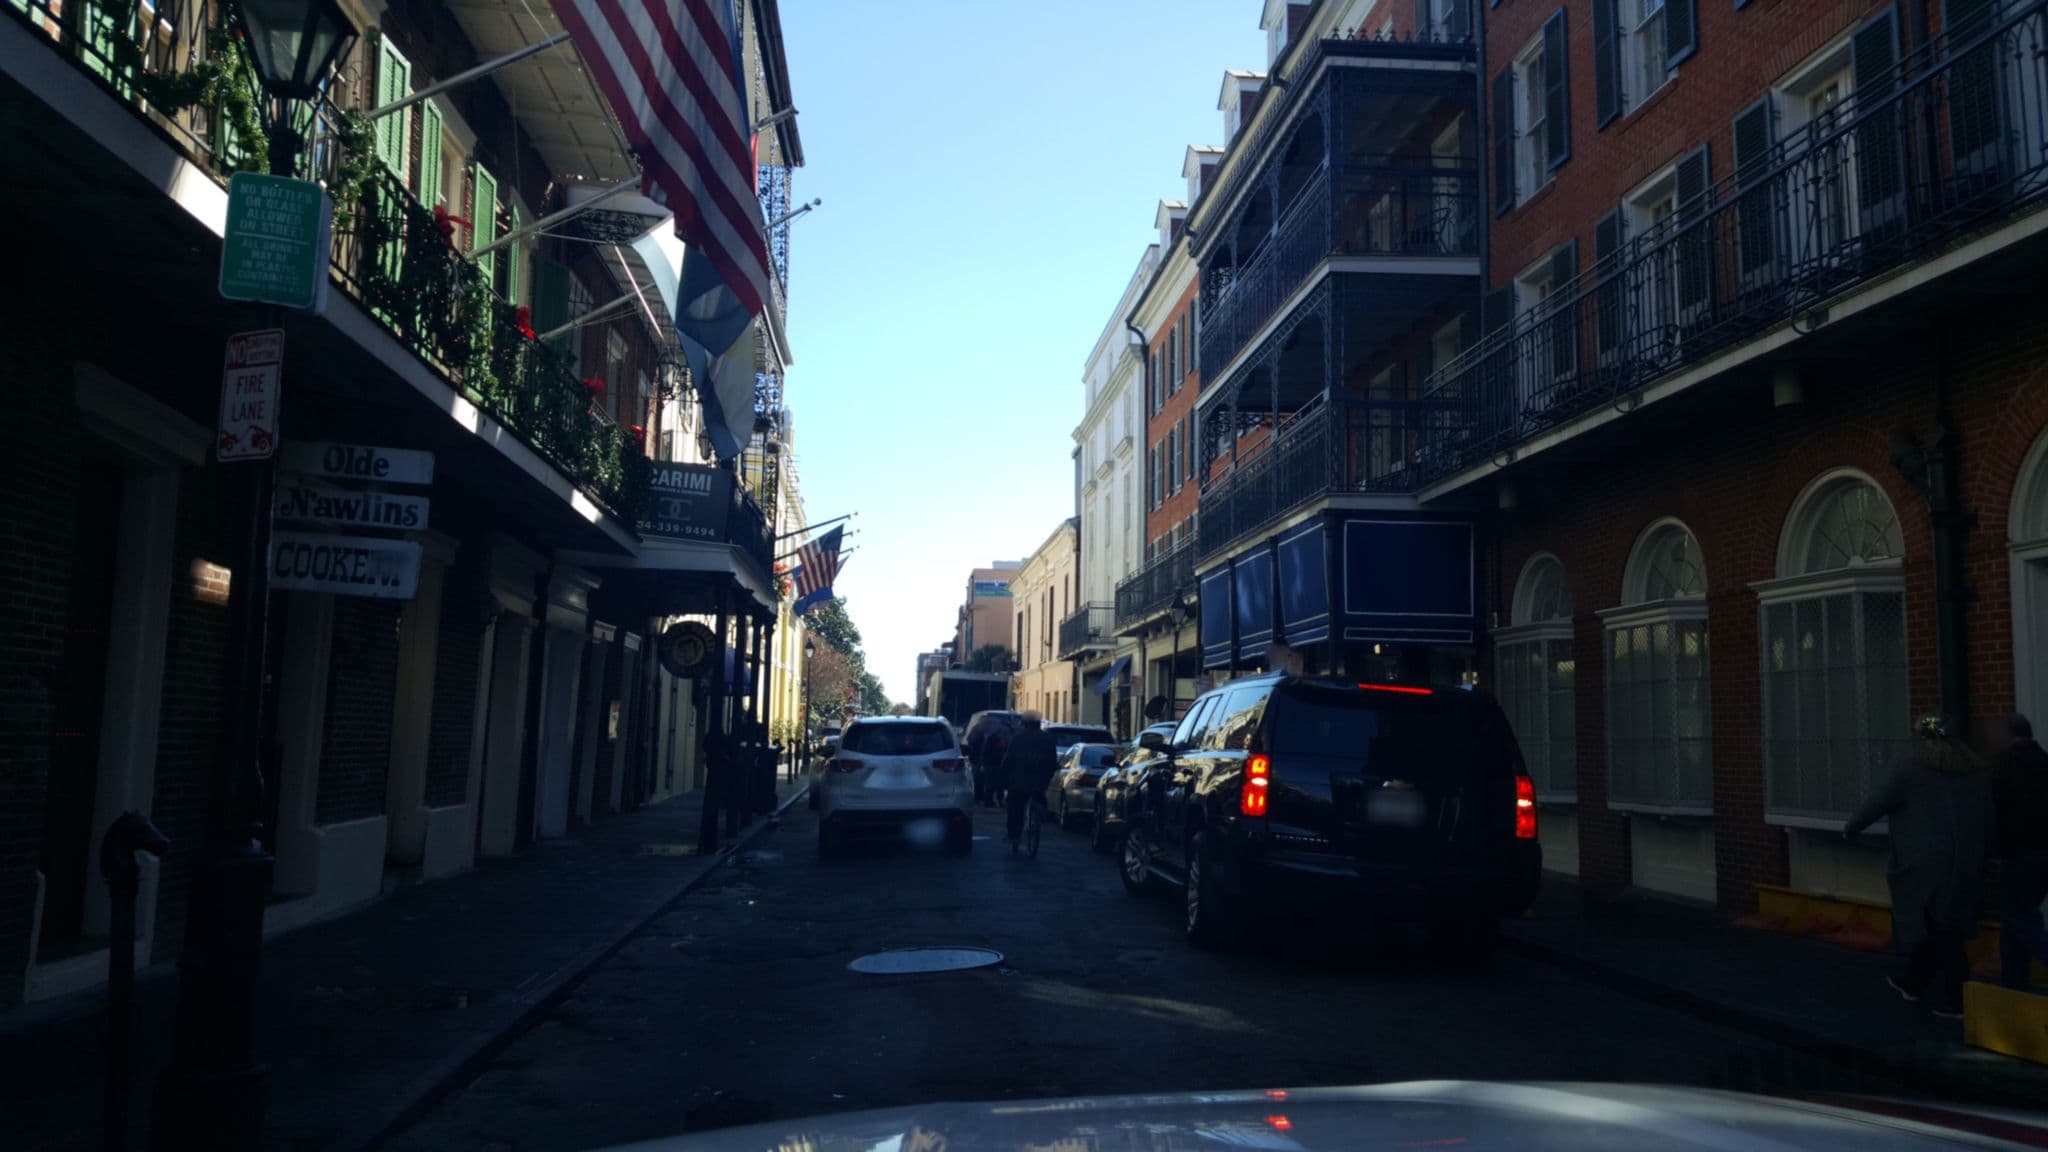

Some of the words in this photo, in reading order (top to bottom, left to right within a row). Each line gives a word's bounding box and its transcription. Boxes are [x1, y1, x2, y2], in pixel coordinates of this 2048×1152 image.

[239, 183, 256, 195] NO
[247, 208, 302, 226] ALLOWED
[236, 374, 265, 394] FIRE
[231, 401, 265, 422] LANE
[323, 445, 390, 478] Olde
